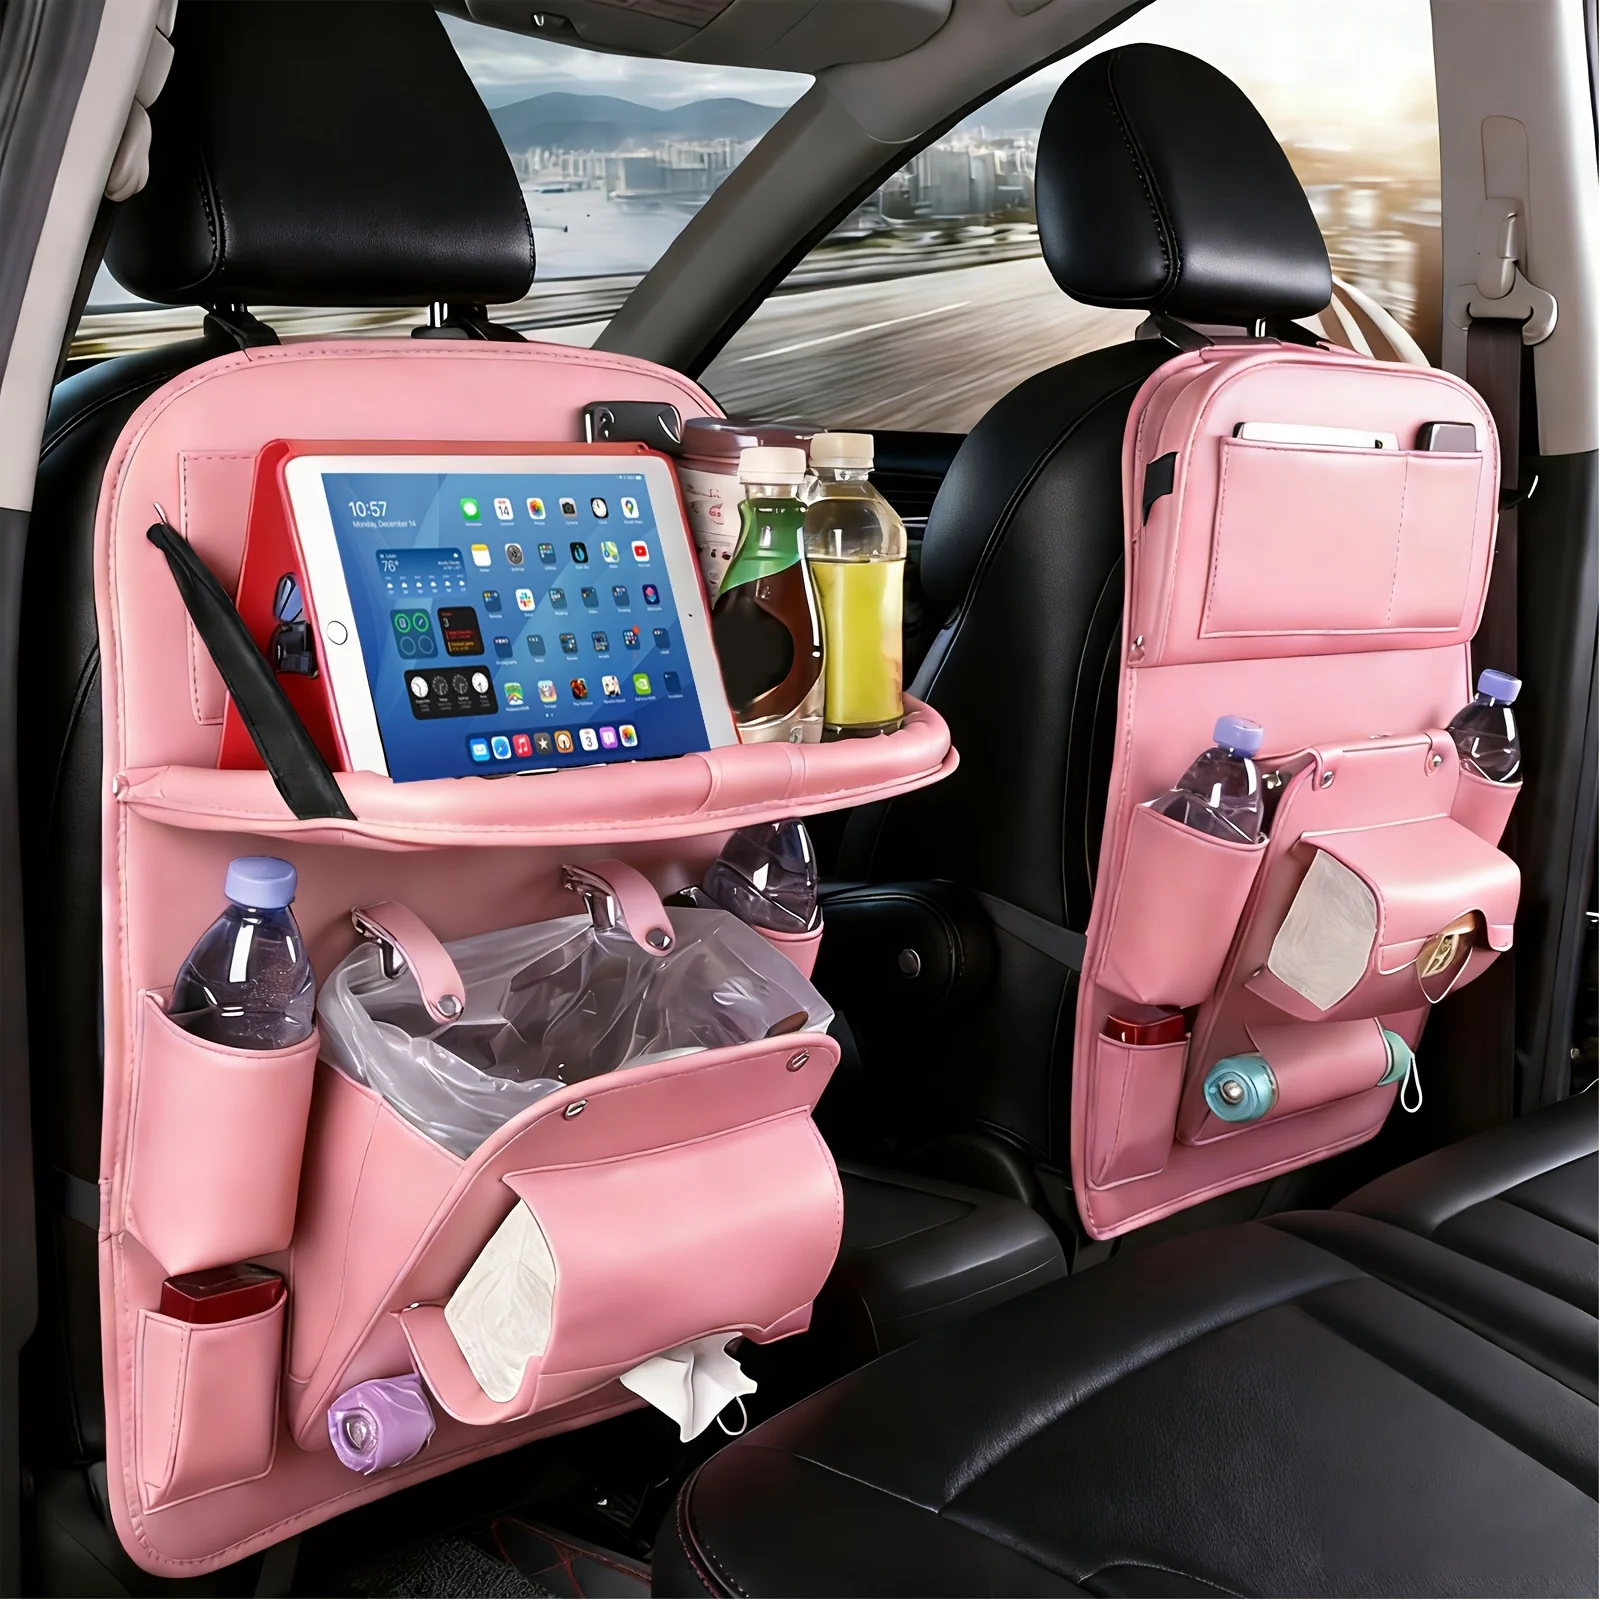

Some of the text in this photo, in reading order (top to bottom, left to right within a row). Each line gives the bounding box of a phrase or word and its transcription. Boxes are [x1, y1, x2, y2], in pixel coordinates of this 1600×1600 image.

[348, 501, 387, 517] 10:57
[498, 506, 510, 516] 14
[378, 519, 408, 528] December
[408, 519, 417, 527] 14
[442, 617, 450, 628] 3
[585, 736, 593, 748] 3
